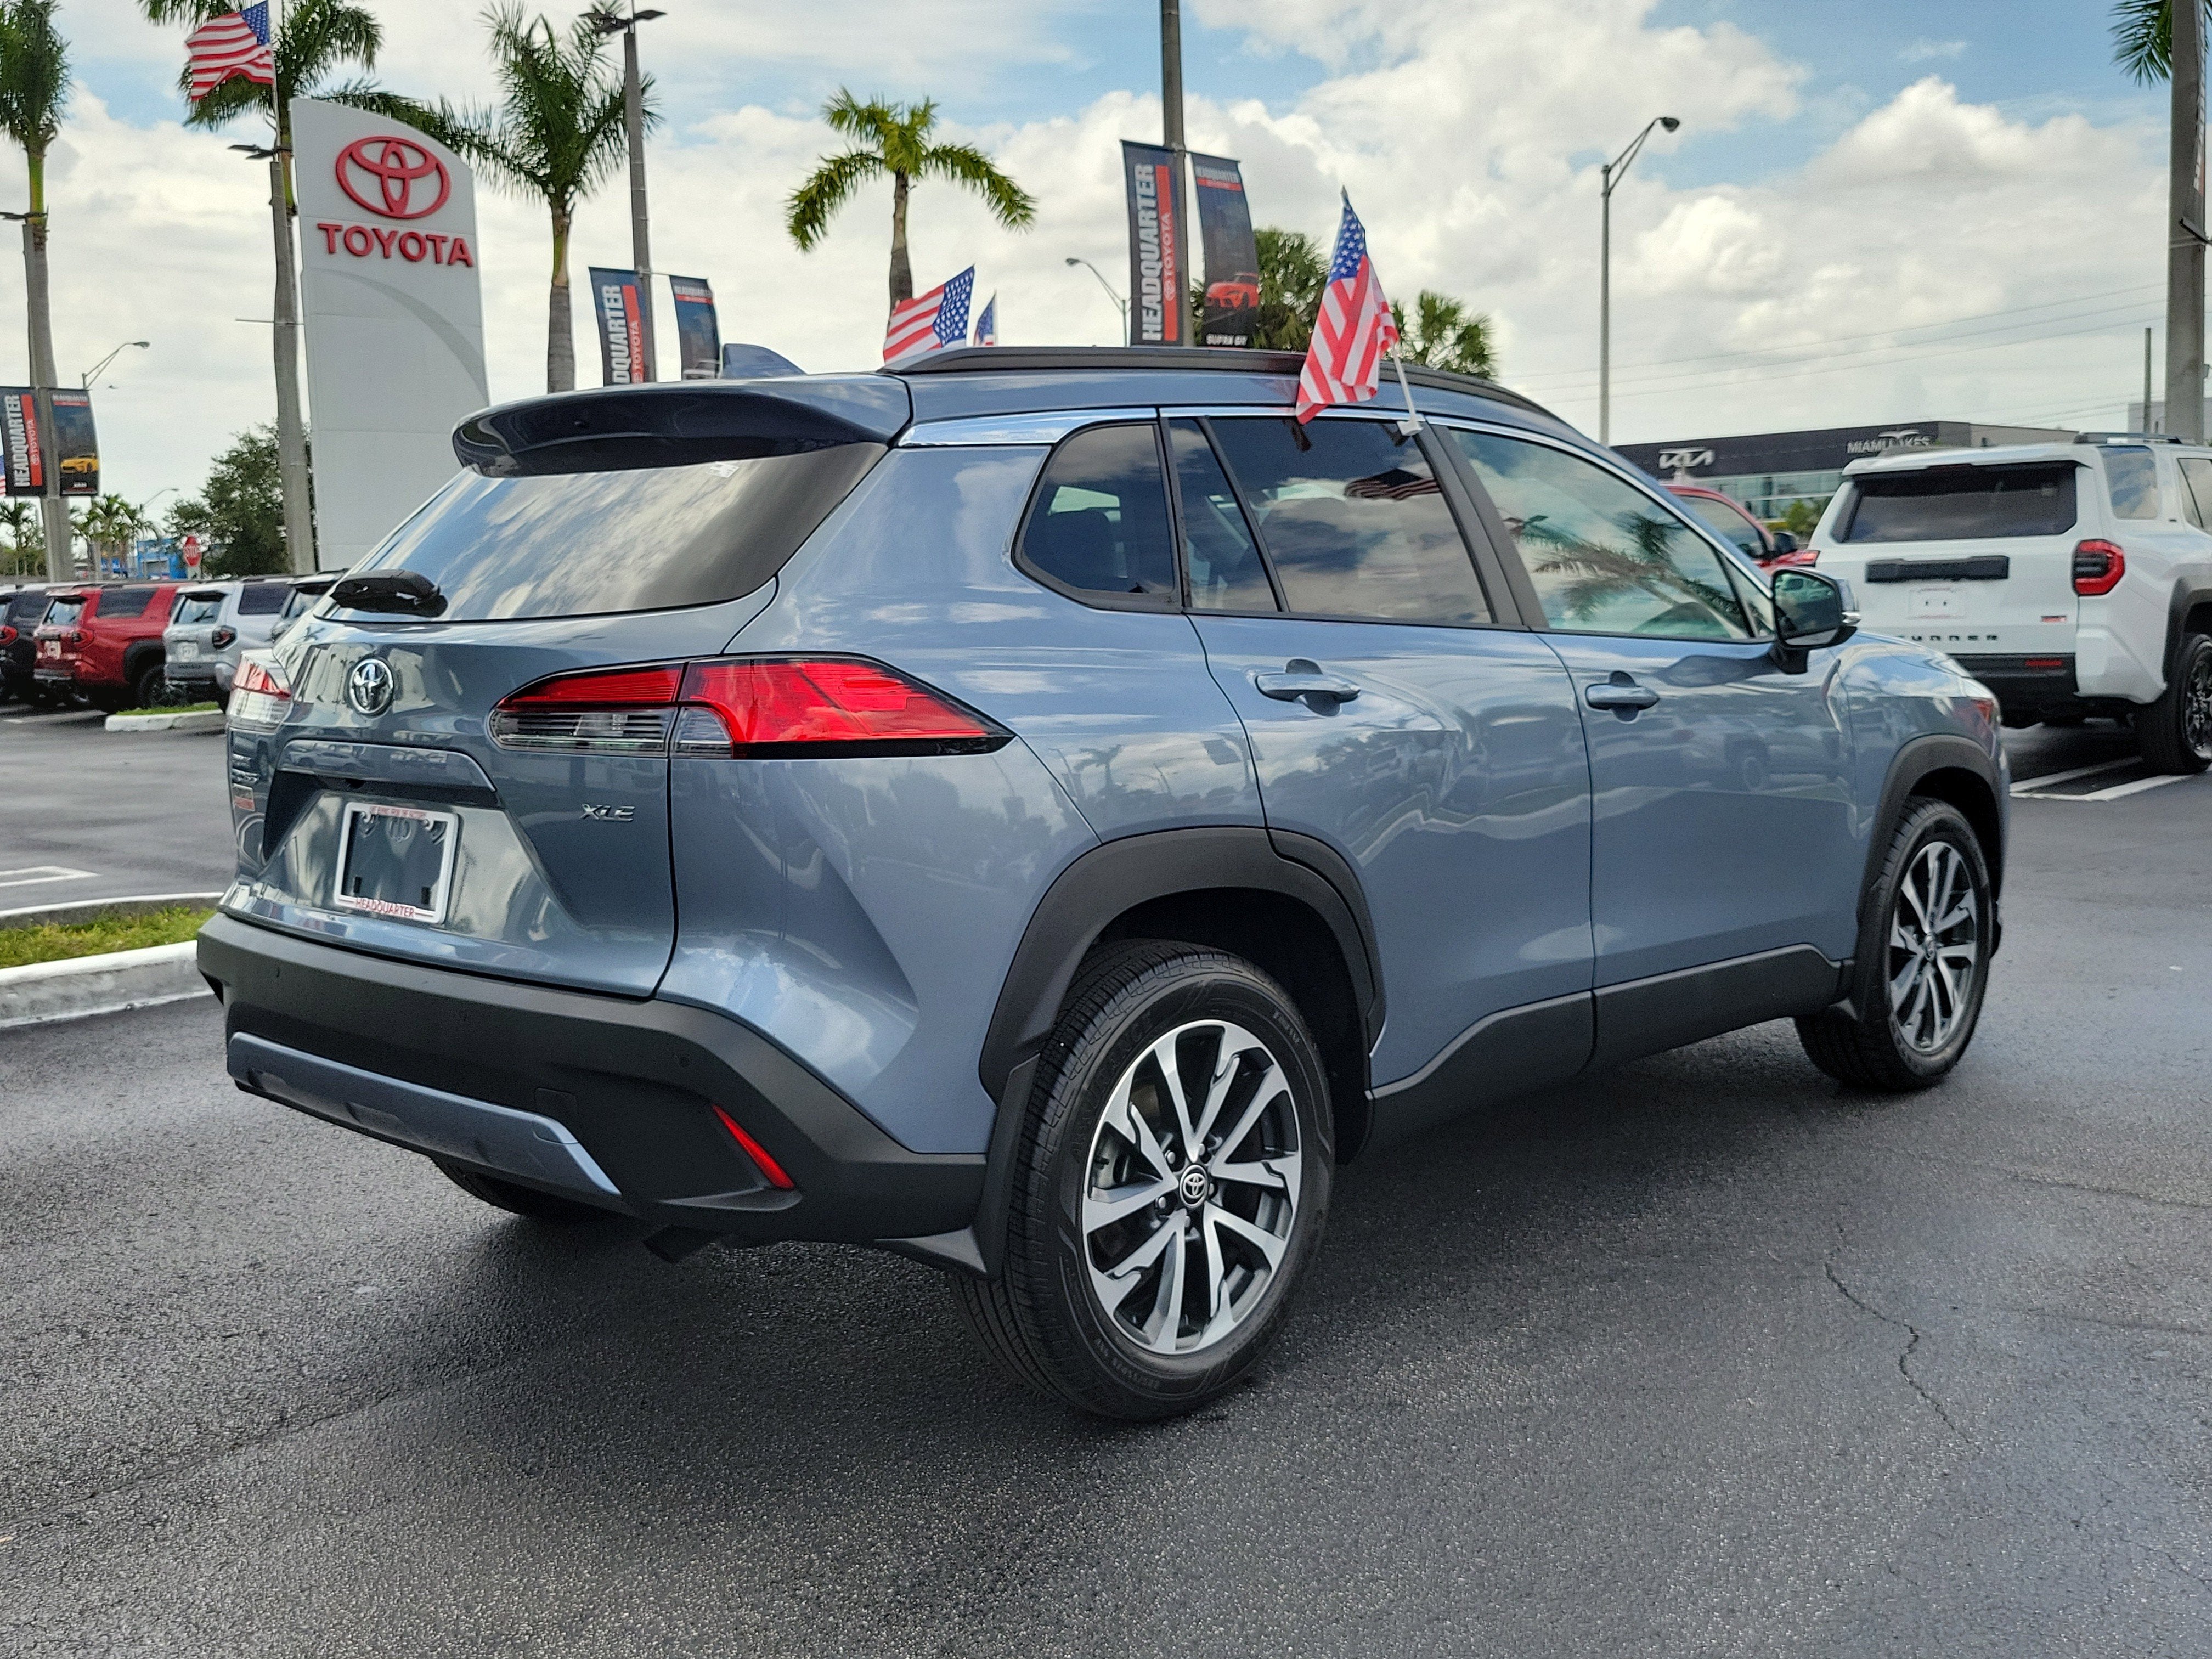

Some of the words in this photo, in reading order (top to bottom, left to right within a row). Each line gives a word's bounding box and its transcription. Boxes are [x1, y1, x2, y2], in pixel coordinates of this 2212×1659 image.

[317, 223, 474, 268] TOYOTA
[1134, 164, 1163, 341] HEADQUARTER
[1161, 212, 1174, 278] TOYOTA
[602, 285, 631, 383] DQUARTER
[629, 320, 641, 369] TOYOTA
[5, 394, 31, 487] HEADQUARTER
[26, 419, 39, 454] TOYOTA
[1658, 449, 1714, 469] KIA
[579, 803, 635, 822] XLE
[356, 898, 415, 918] HEADQUARTER
